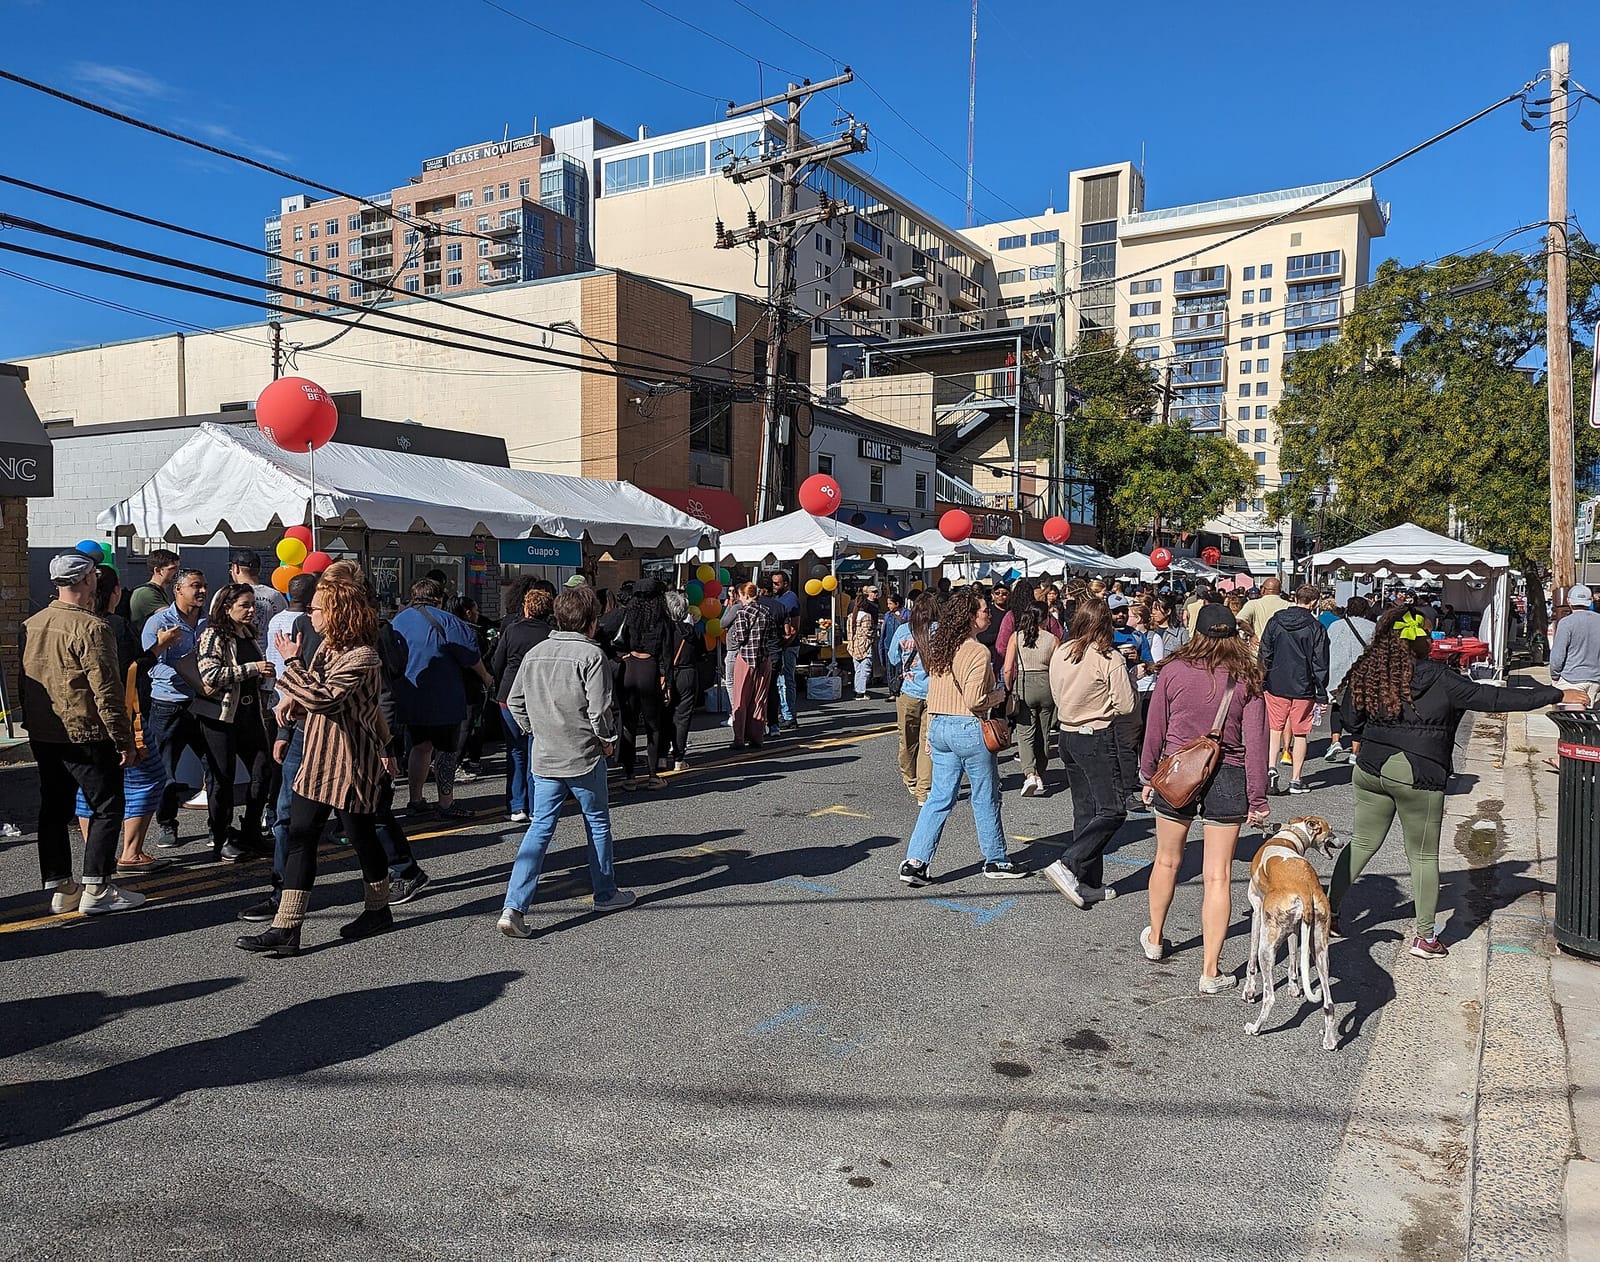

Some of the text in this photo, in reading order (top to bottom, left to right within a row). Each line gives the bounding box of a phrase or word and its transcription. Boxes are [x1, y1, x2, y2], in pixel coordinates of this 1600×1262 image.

[450, 143, 509, 166] LEASE NOW
[862, 439, 892, 462] IGNITE
[527, 545, 560, 558] Guapo's
